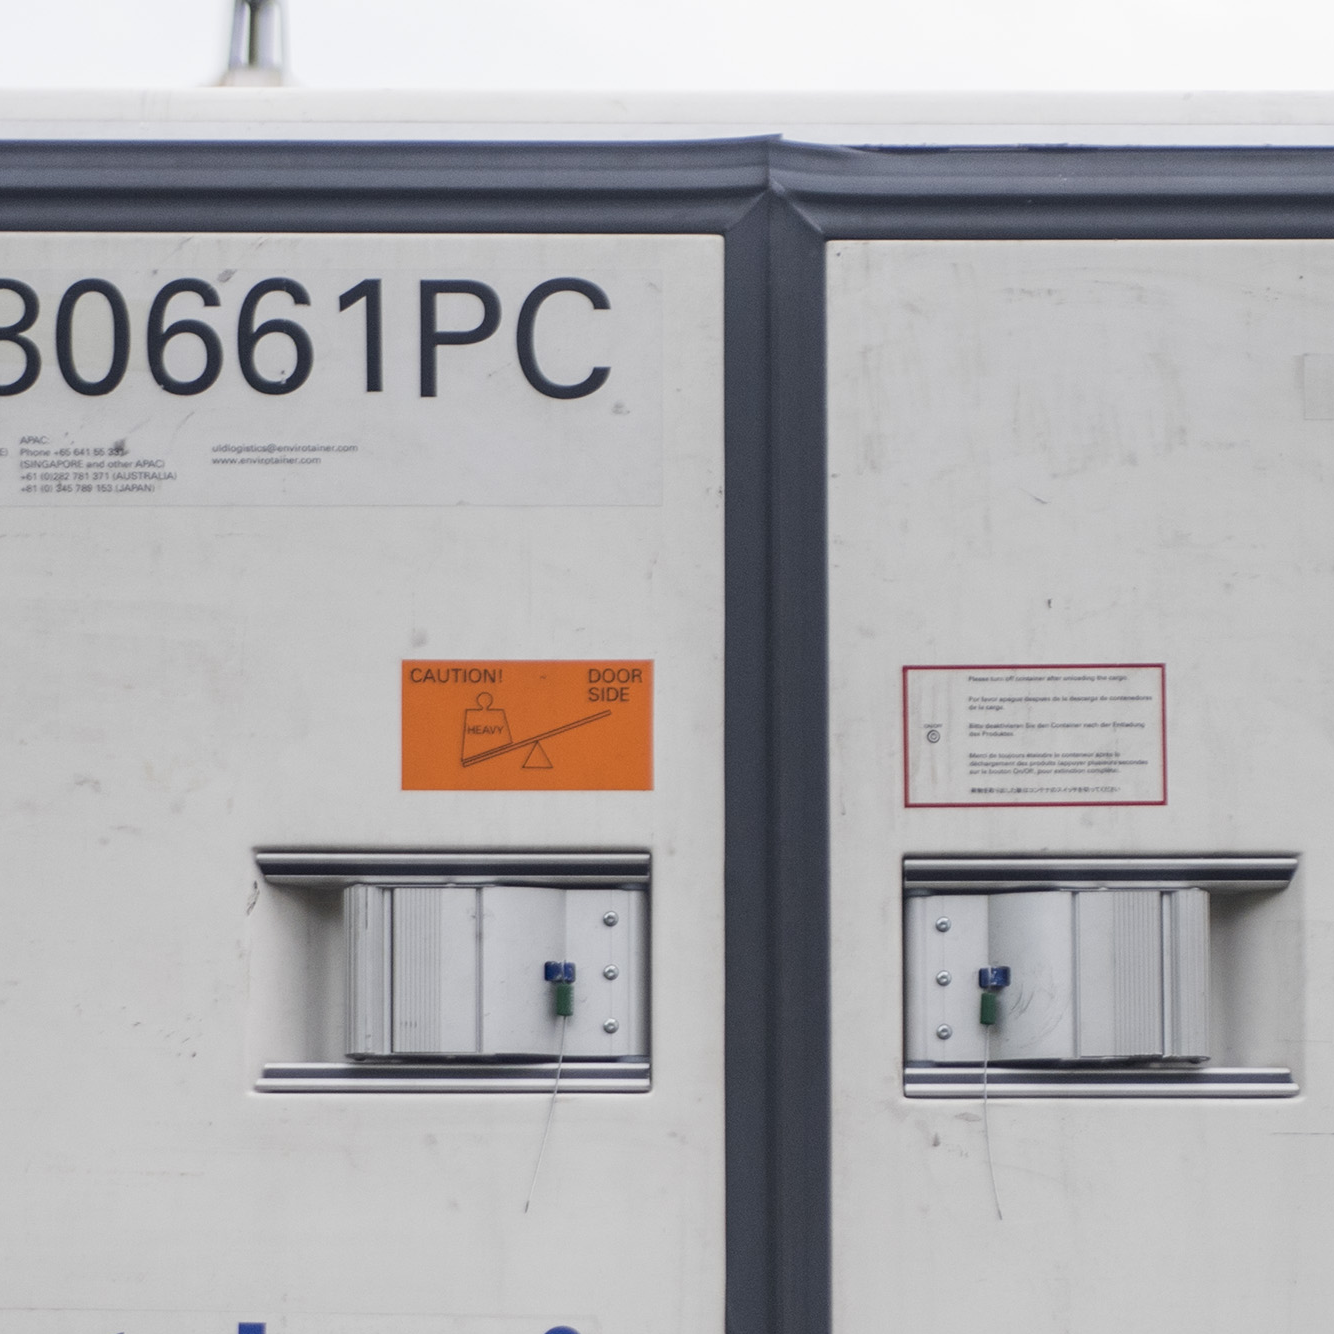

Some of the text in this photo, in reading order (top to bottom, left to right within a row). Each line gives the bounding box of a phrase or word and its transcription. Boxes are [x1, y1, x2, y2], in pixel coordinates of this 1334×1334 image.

[20, 447, 50, 457] Phone
[211, 443, 359, 455] uldlogistics@envirotainer.com
[20, 459, 83, 469] (SINGAPORE
[86, 459, 105, 469] and
[107, 459, 132, 469] other
[211, 456, 322, 465] www.envirotainer.com
[112, 471, 177, 481] (AUSTRALIA)
[115, 484, 156, 493] (JAPAN)
[410, 668, 503, 683] CAUTION!
[588, 668, 643, 683] DOOR
[588, 687, 630, 702] SIDE
[467, 725, 504, 735] HEAVY
